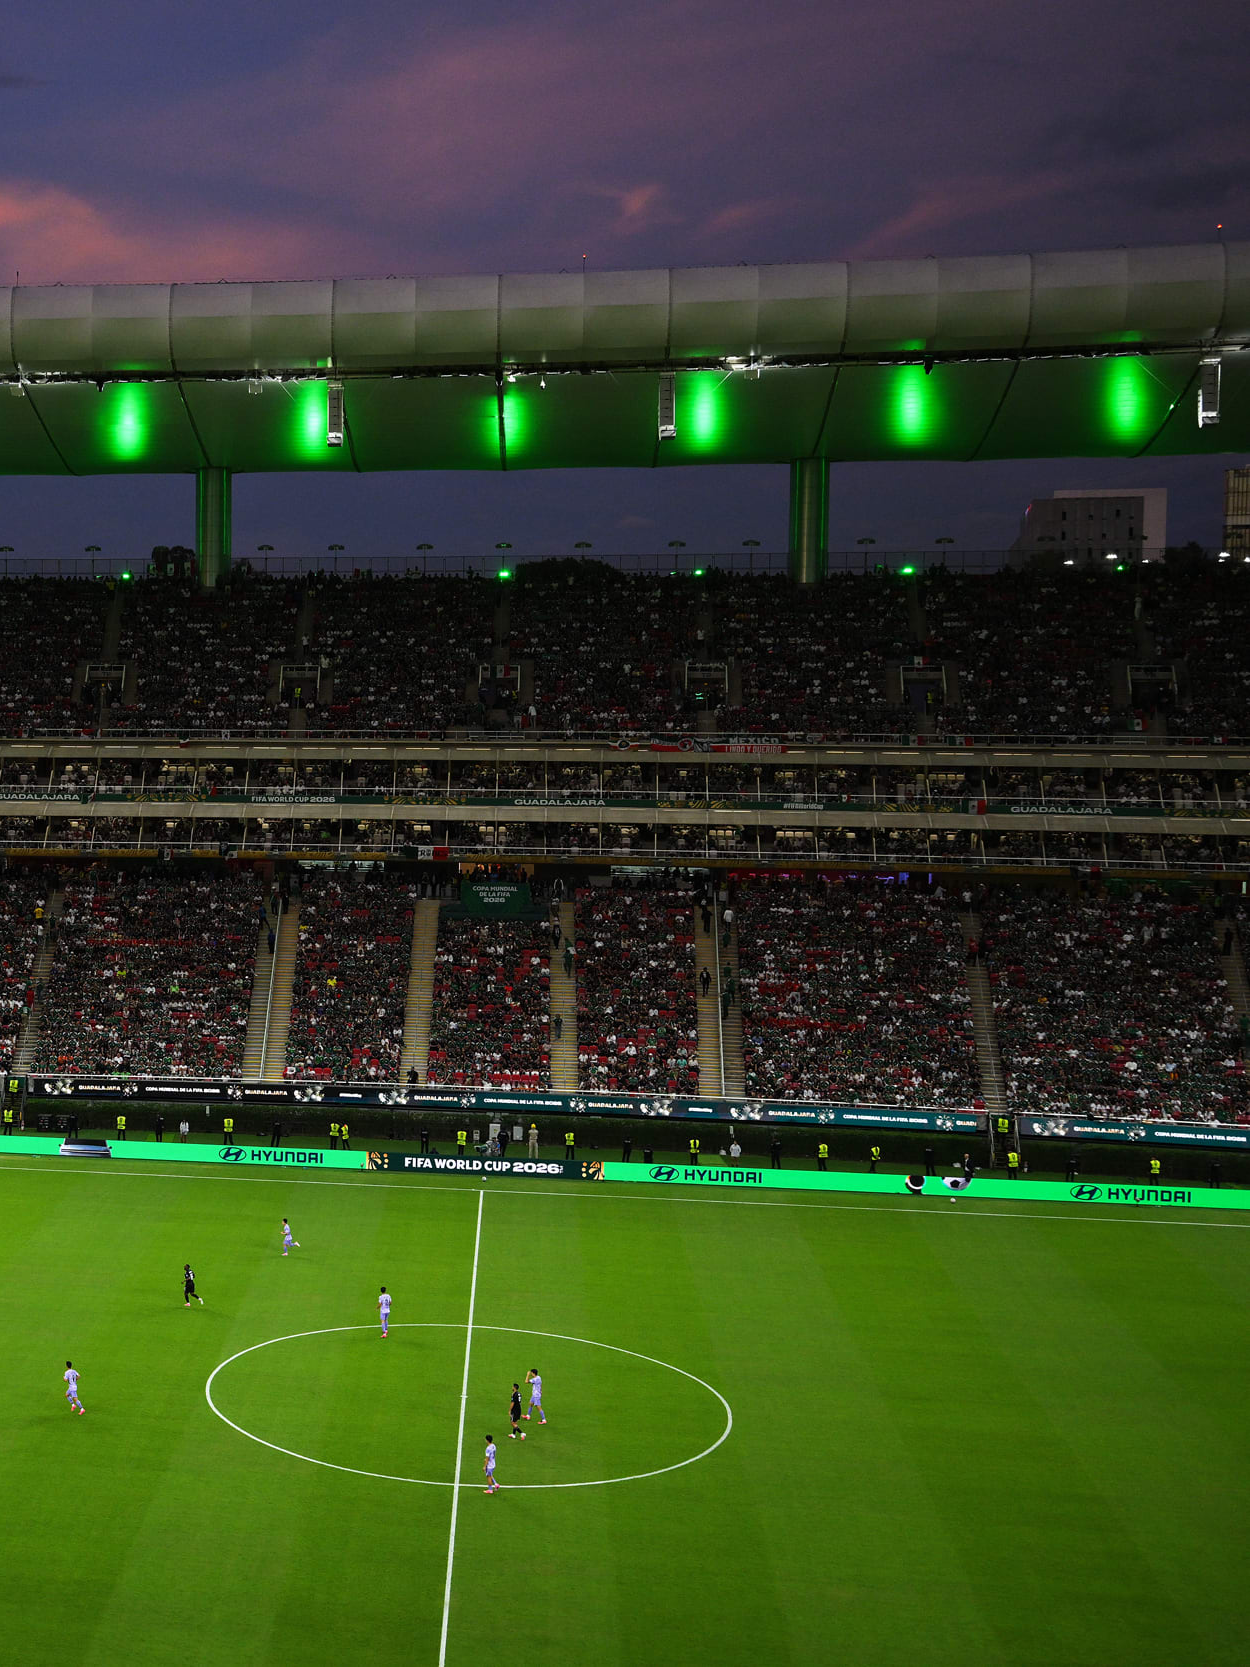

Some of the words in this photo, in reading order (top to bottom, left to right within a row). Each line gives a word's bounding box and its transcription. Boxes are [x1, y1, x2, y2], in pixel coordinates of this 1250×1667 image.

[1010, 806, 1113, 815] GUADALAJARA
[251, 1150, 323, 1165] HYUNDAI
[405, 1157, 432, 1168] FIFA
[434, 1158, 482, 1170] WORLD
[484, 1161, 511, 1172] CUP
[684, 1168, 762, 1184] HYUNDAI
[1108, 1188, 1191, 1203] HYUNDAI
